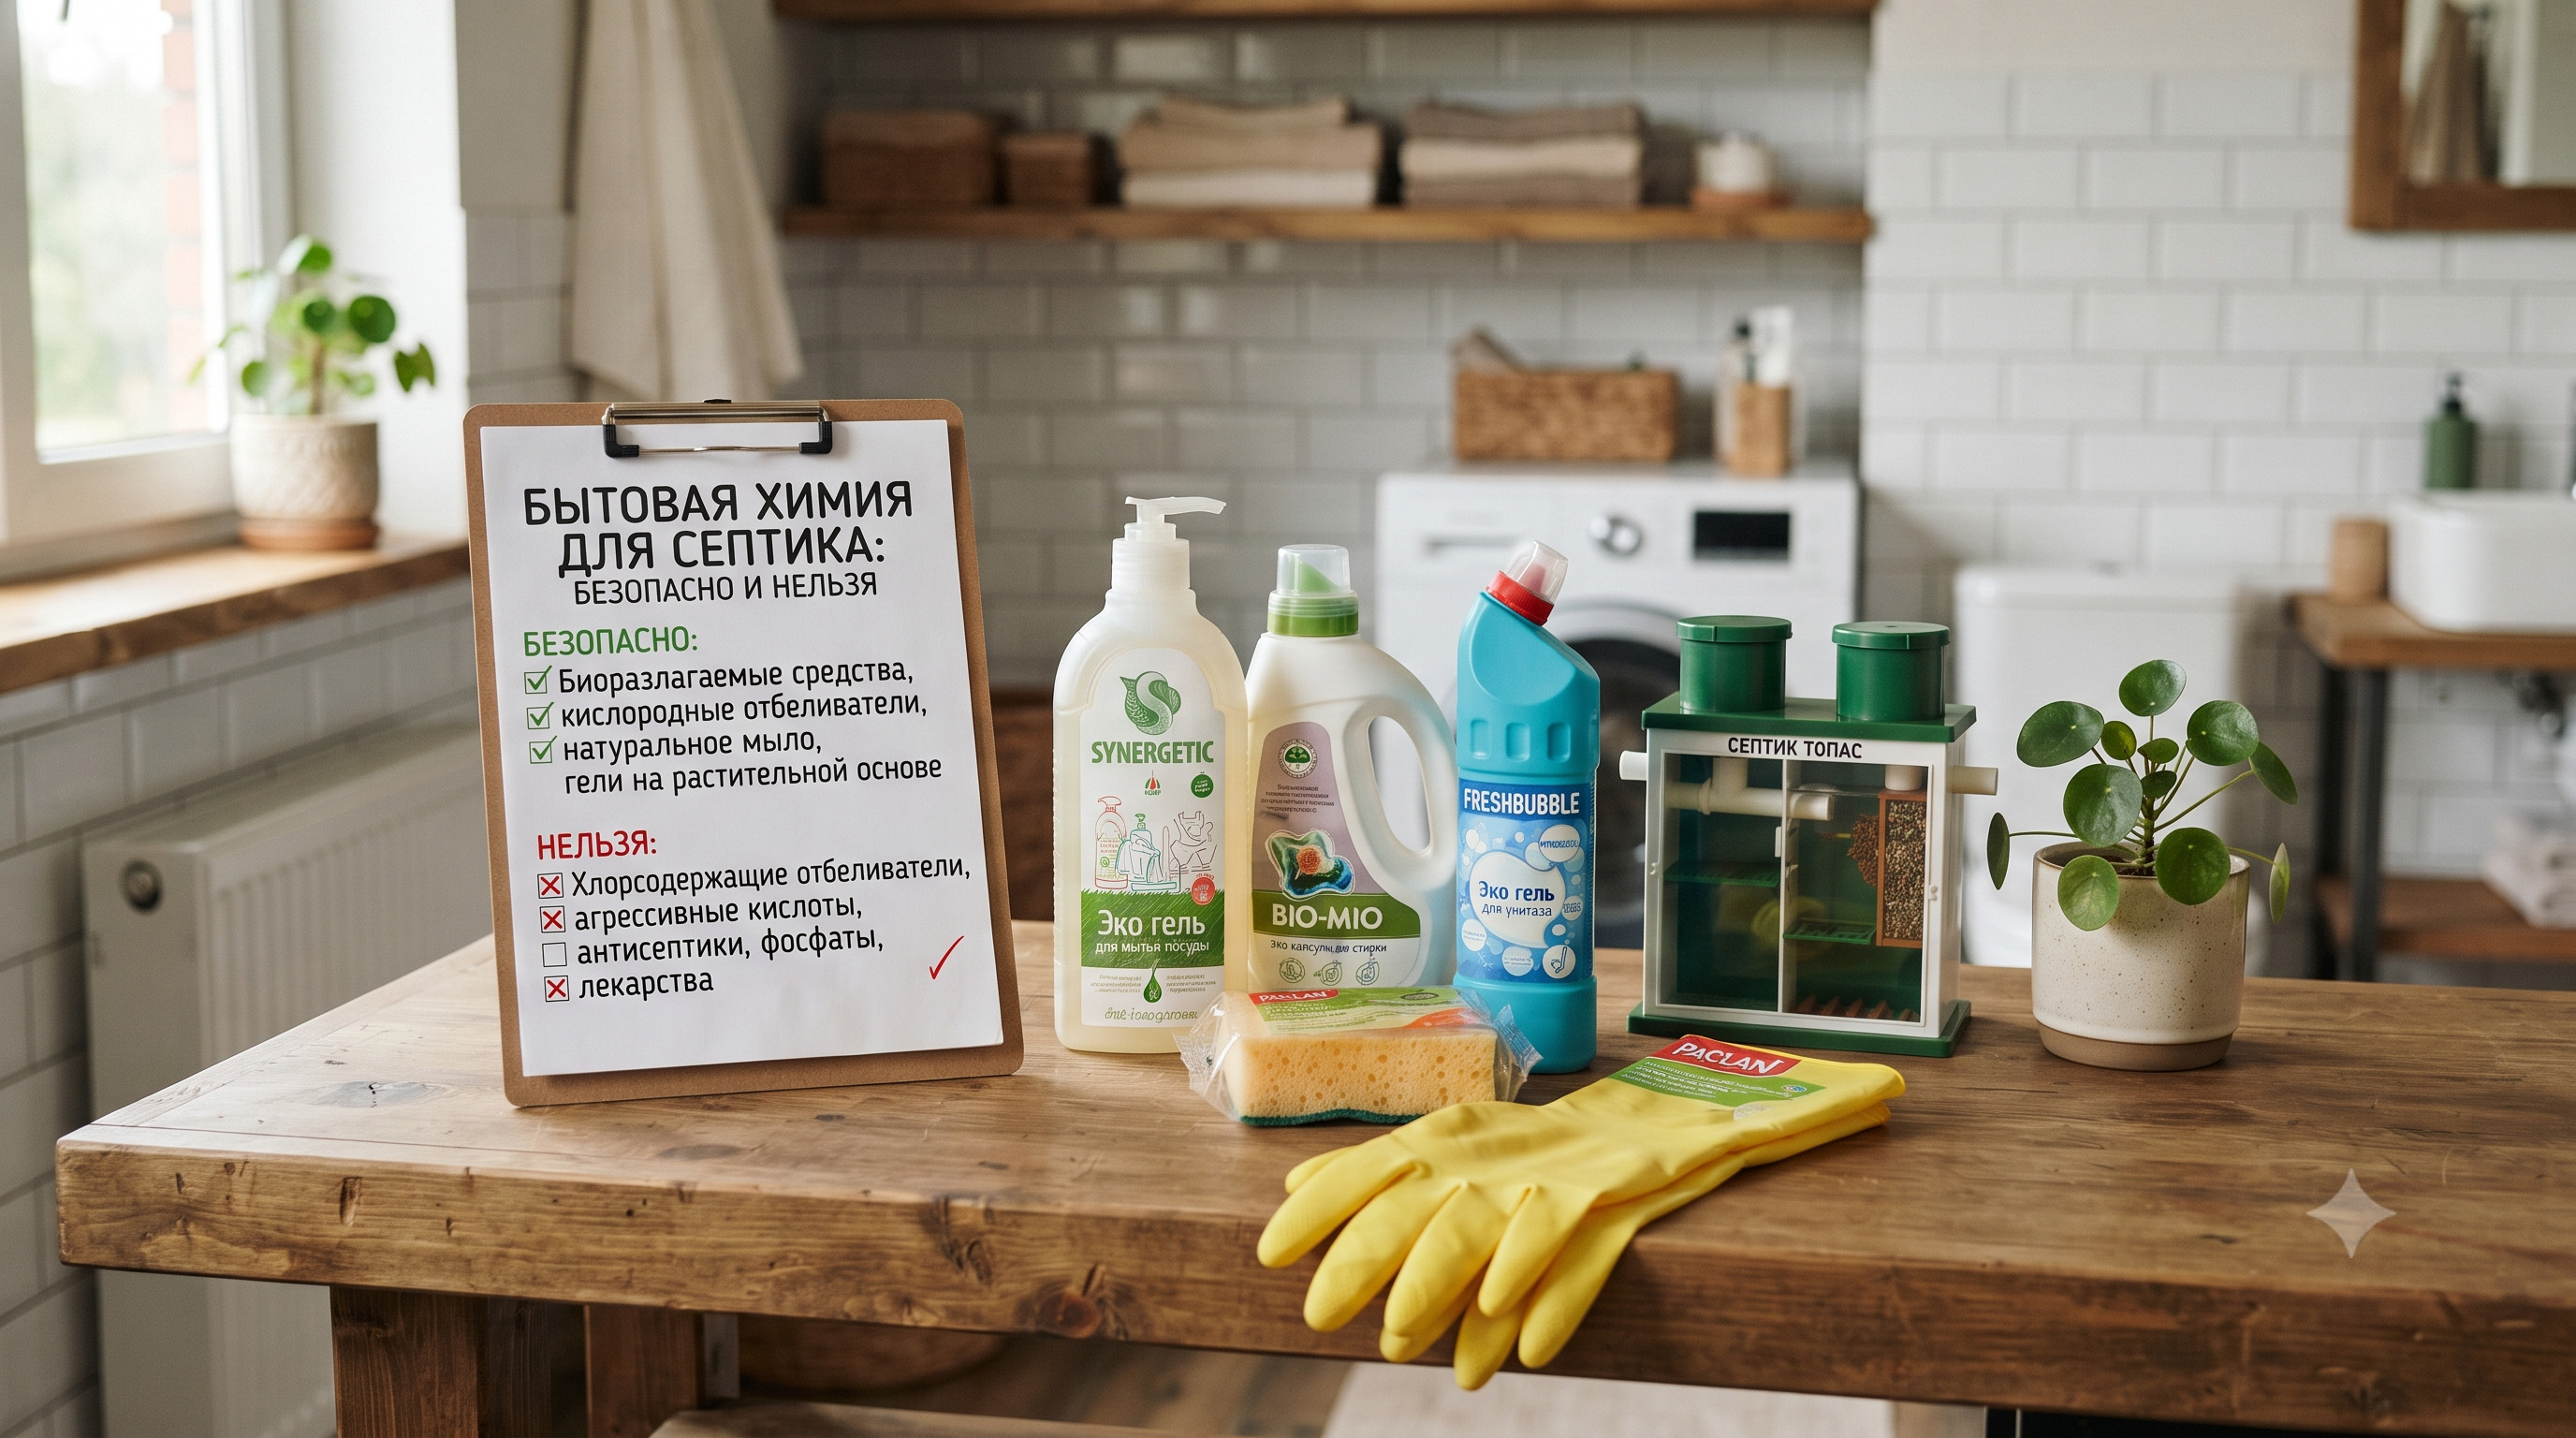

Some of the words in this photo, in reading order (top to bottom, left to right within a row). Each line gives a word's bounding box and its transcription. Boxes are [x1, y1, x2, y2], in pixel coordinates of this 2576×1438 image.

[524, 485, 738, 525] БЫТОВАЯ
[755, 481, 912, 520] ХИМИЯ
[559, 532, 653, 579] ДЛЯ
[673, 526, 884, 567] СЕПТИКА:
[575, 577, 733, 605] БЕЗОПАСНО
[745, 576, 762, 599] И
[773, 572, 876, 598] НЕЛЬЗЯ
[524, 626, 697, 656] БЕЗОПАСНО:
[560, 667, 782, 698] Биоразлагаемые
[793, 662, 913, 691] средства,
[563, 702, 734, 731] кислородные
[744, 693, 926, 719] отбеливатели,
[564, 735, 732, 766] натуральное
[743, 731, 821, 754] мыло,
[1091, 741, 1214, 764] SYNERGETIC
[1728, 737, 1797, 756] СЕПТИК
[1804, 741, 1862, 758] ТОПАС
[565, 774, 622, 794] гели
[634, 772, 664, 791] на
[673, 757, 847, 796] растительной
[857, 759, 941, 781] основе
[1464, 787, 1580, 815] FRESHBUBBLE
[538, 830, 656, 859] НЕЛЬЗЯ:
[572, 868, 787, 901] Хлорсодержащие
[798, 858, 970, 884] отбеливатели,
[1479, 880, 1509, 900] Эко
[1515, 888, 1555, 902] гель
[576, 903, 739, 935] агрессивные
[749, 897, 861, 920] кислоты,
[1098, 909, 1143, 936] Эко
[1151, 916, 1206, 936] гель
[1272, 903, 1383, 930] BIO-MIO
[1506, 906, 1552, 918] унитаза
[578, 937, 750, 964] антисептики,
[762, 925, 883, 961] фосфаты,
[1095, 943, 1118, 955] для
[1121, 943, 1161, 952] мытья
[1164, 942, 1209, 957] посуды
[579, 973, 713, 1001] лекарства
[1671, 1042, 1785, 1074] PACLAN
